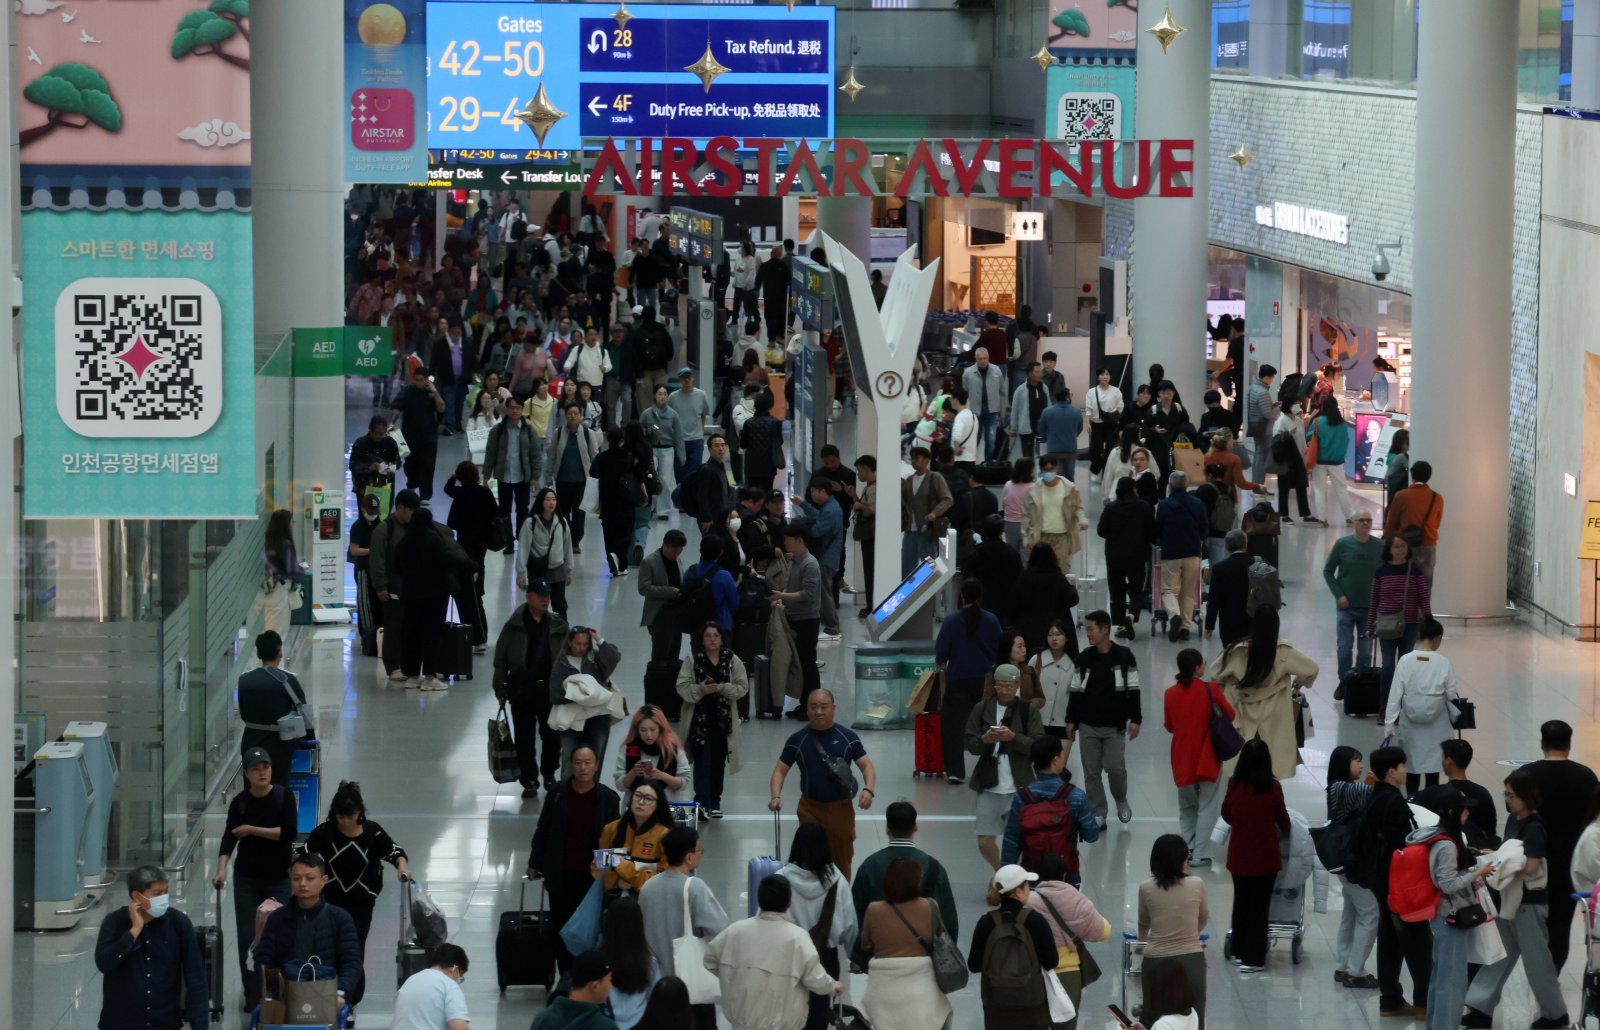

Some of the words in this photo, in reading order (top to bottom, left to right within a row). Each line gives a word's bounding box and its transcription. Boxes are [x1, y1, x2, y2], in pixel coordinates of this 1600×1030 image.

[497, 16, 543, 33] Gates
[613, 29, 633, 47] 28
[725, 39, 746, 55] Tax
[748, 39, 796, 56] Refund,
[797, 40, 822, 56] 退税
[438, 40, 545, 77] 42-50
[612, 94, 633, 112] 4F
[649, 102, 676, 119] Duty
[678, 102, 703, 117] Free
[705, 102, 751, 119] Pick-up,
[753, 103, 821, 118] 免税品领取处
[438, 96, 533, 132] 29-4
[361, 128, 404, 138] AIRSTAR
[459, 149, 495, 159] 42-50
[500, 152, 518, 160] Gates
[524, 149, 558, 160] 29-41
[427, 168, 454, 179] nsfer
[456, 168, 484, 179] Desk
[581, 136, 877, 197] AIRSTAR
[893, 136, 1194, 199] AVENUE
[521, 171, 563, 183] Transfer
[60, 239, 137, 260] 스마트한
[140, 240, 216, 262] 면세쇼핑
[312, 341, 336, 353] AED
[355, 357, 378, 367] AED
[61, 452, 219, 474] 인천공항면세점앱
